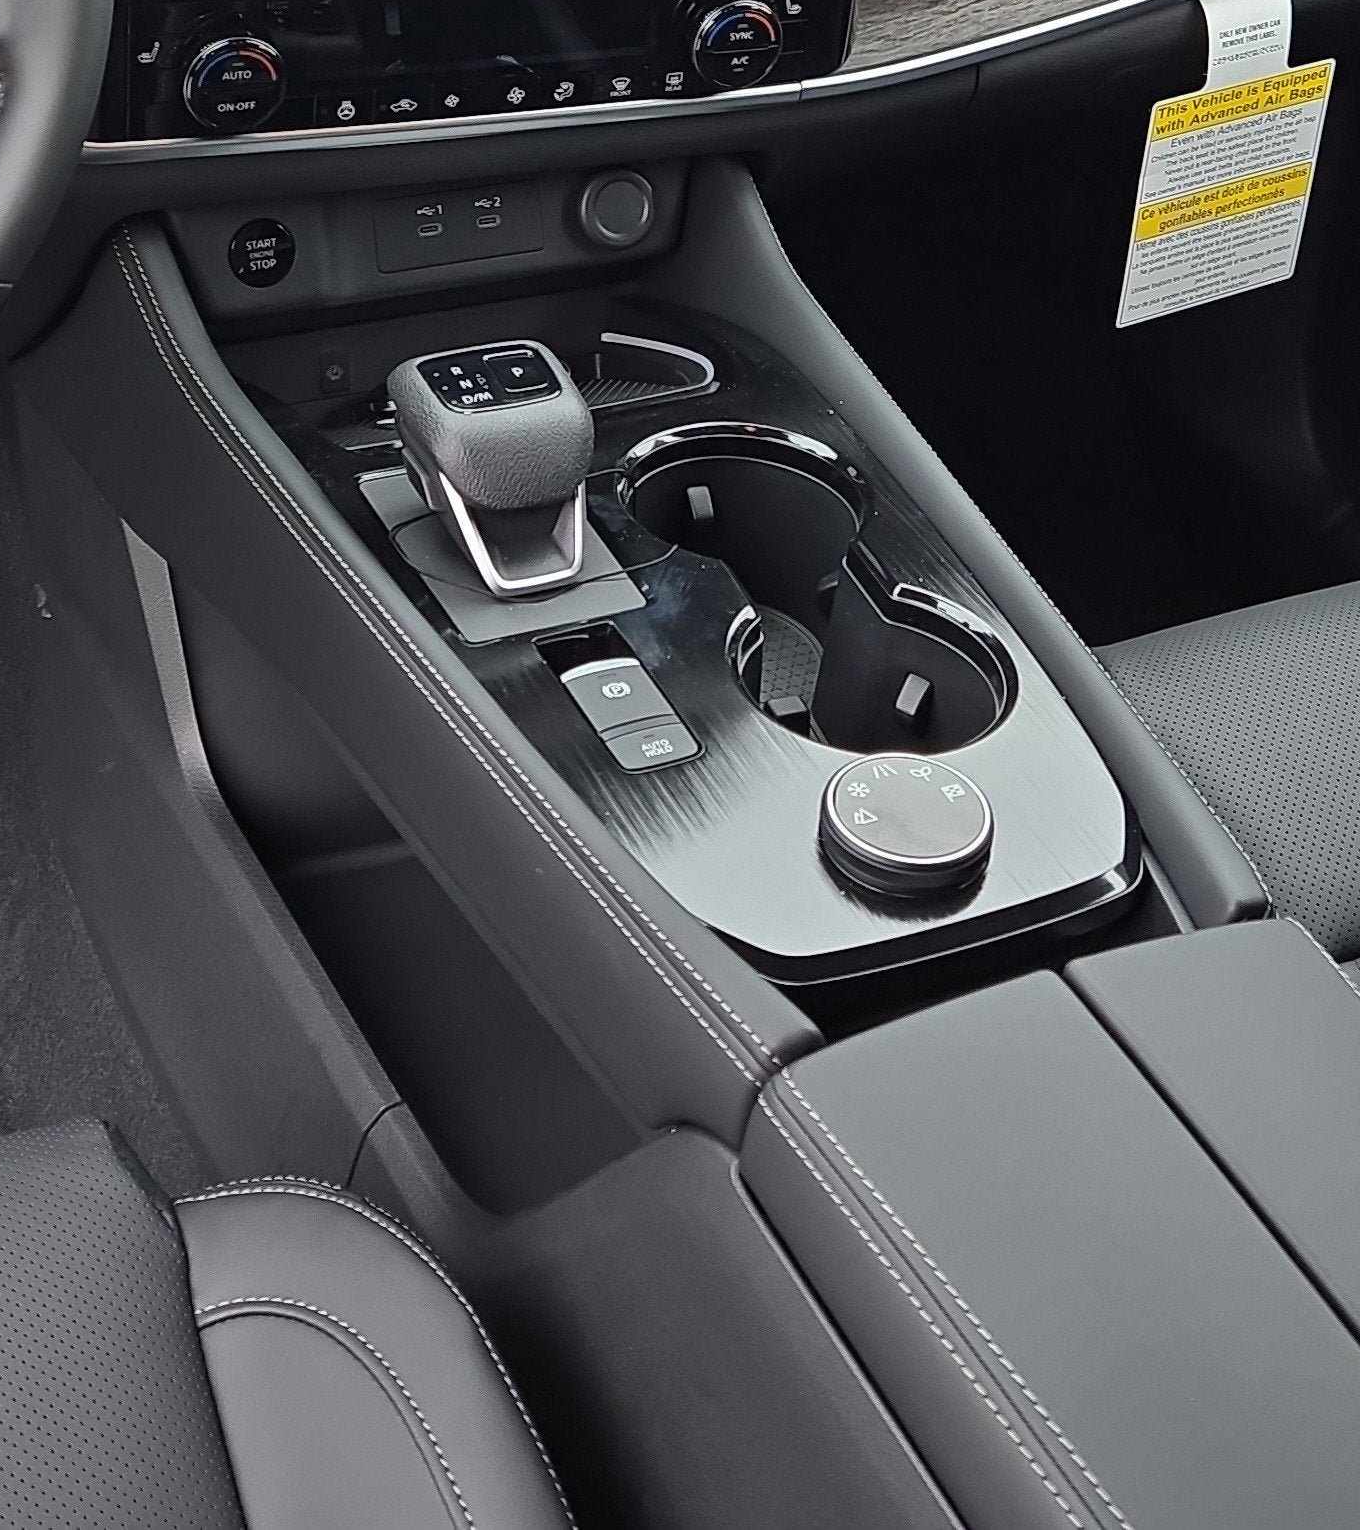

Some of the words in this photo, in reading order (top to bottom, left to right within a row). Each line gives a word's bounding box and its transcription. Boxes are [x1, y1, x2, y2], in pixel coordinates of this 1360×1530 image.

[729, 31, 755, 41] SYNC
[731, 56, 750, 65] A/C
[222, 70, 252, 80] AUTO
[1159, 103, 1188, 118] This
[1192, 90, 1242, 109] Vehicle
[1263, 66, 1327, 92] Equipped
[1155, 118, 1184, 134] with
[1189, 98, 1259, 126] Advanced
[1263, 93, 1285, 107] Air
[1289, 85, 1323, 100] Bags
[1170, 135, 1194, 148] Even
[1197, 129, 1215, 140] with
[1217, 116, 1263, 135] Advanced
[1263, 113, 1278, 123] Air
[1279, 107, 1302, 119] Bags
[1141, 209, 1155, 220] Ce
[1158, 195, 1201, 215] véhicule
[1203, 190, 1220, 203] est
[1222, 182, 1244, 198] doté
[1247, 180, 1259, 191] de
[1262, 168, 1307, 187] coussins
[493, 197, 501, 207] 2
[1159, 208, 1212, 232] gonflables
[1214, 187, 1285, 216] perfectionnés
[246, 237, 276, 251] START
[250, 259, 277, 271] STOP
[450, 366, 463, 375] R
[510, 366, 524, 378] P
[459, 379, 473, 389] N
[461, 391, 494, 404] D/M
[641, 739, 669, 751] AUTO
[644, 745, 674, 758] HOLD
